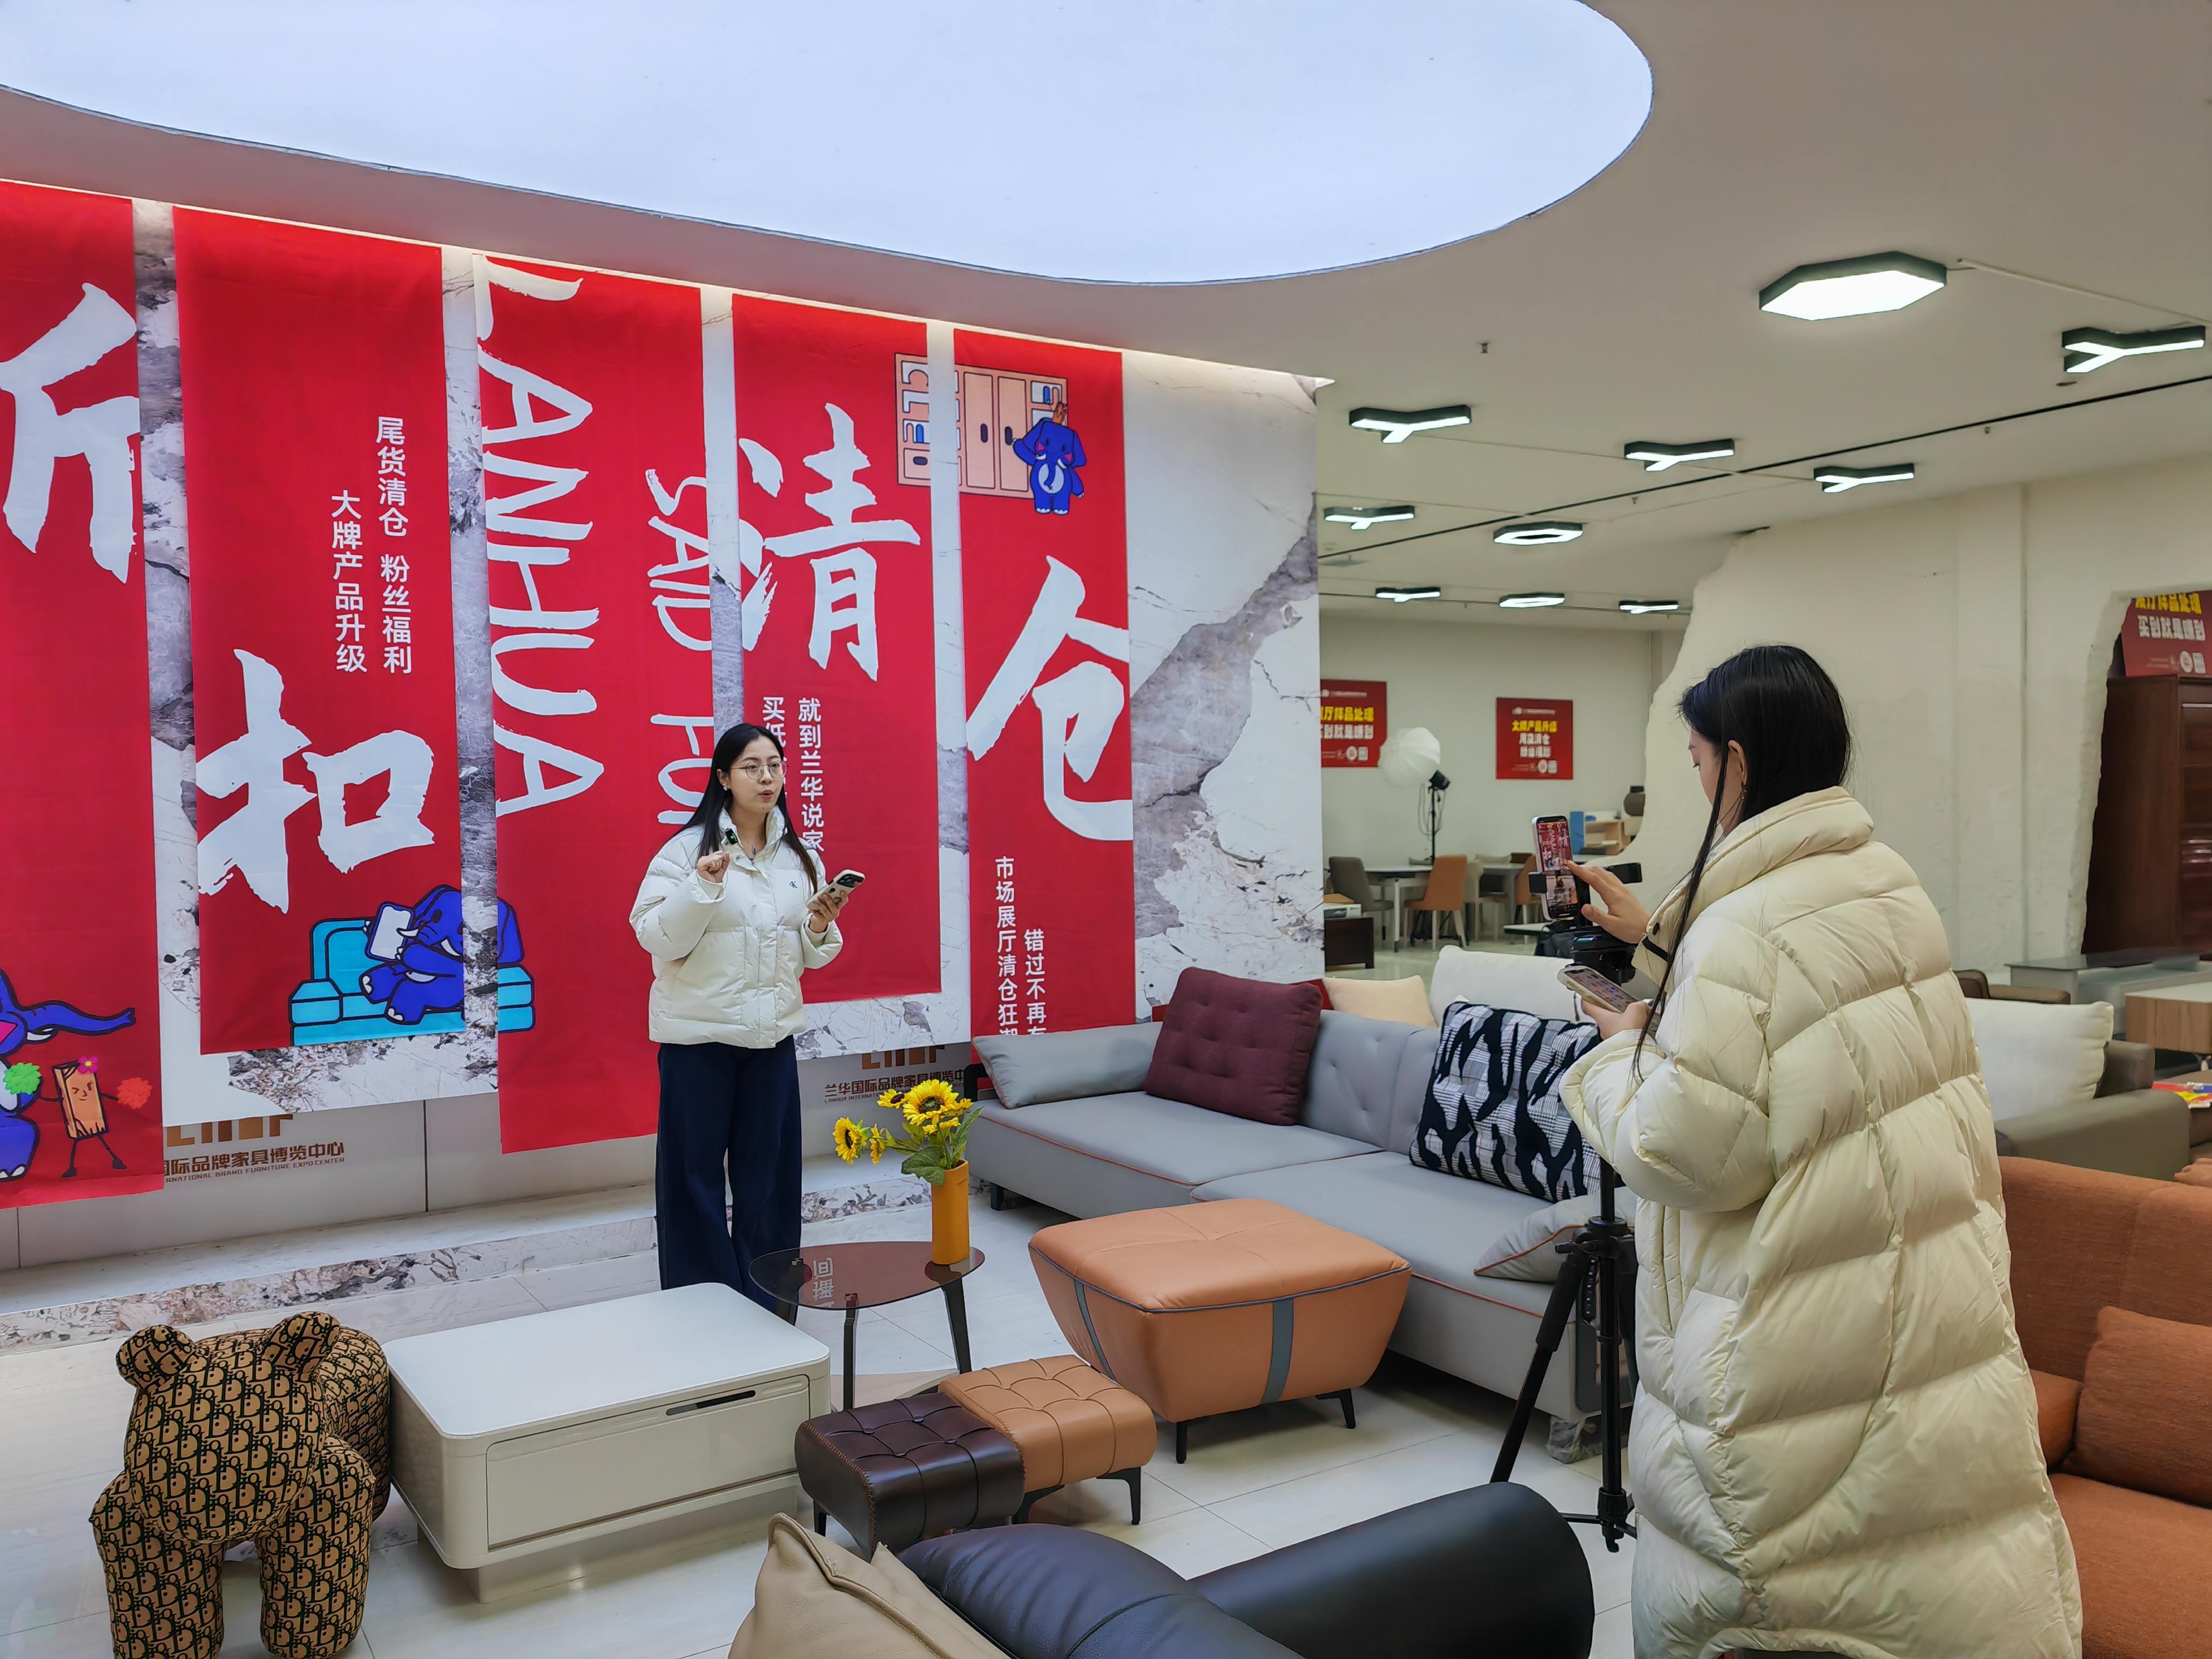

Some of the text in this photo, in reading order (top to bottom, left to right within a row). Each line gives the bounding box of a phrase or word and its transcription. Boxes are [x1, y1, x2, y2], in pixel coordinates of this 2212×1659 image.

[331, 489, 367, 673] 大牌产品升级
[376, 416, 412, 674] 尾货清仓 粉丝福利
[473, 256, 604, 818] LANHUA
[739, 402, 921, 682] 清
[195, 649, 435, 914] 扣
[798, 697, 825, 852] 就到兰华说家
[967, 555, 1134, 841] 仓
[215, 1169, 242, 1177] BRAND
[246, 1163, 290, 1174] FURNITURE
[293, 1161, 313, 1170] EXPO
[315, 1157, 345, 1165] CENTER
